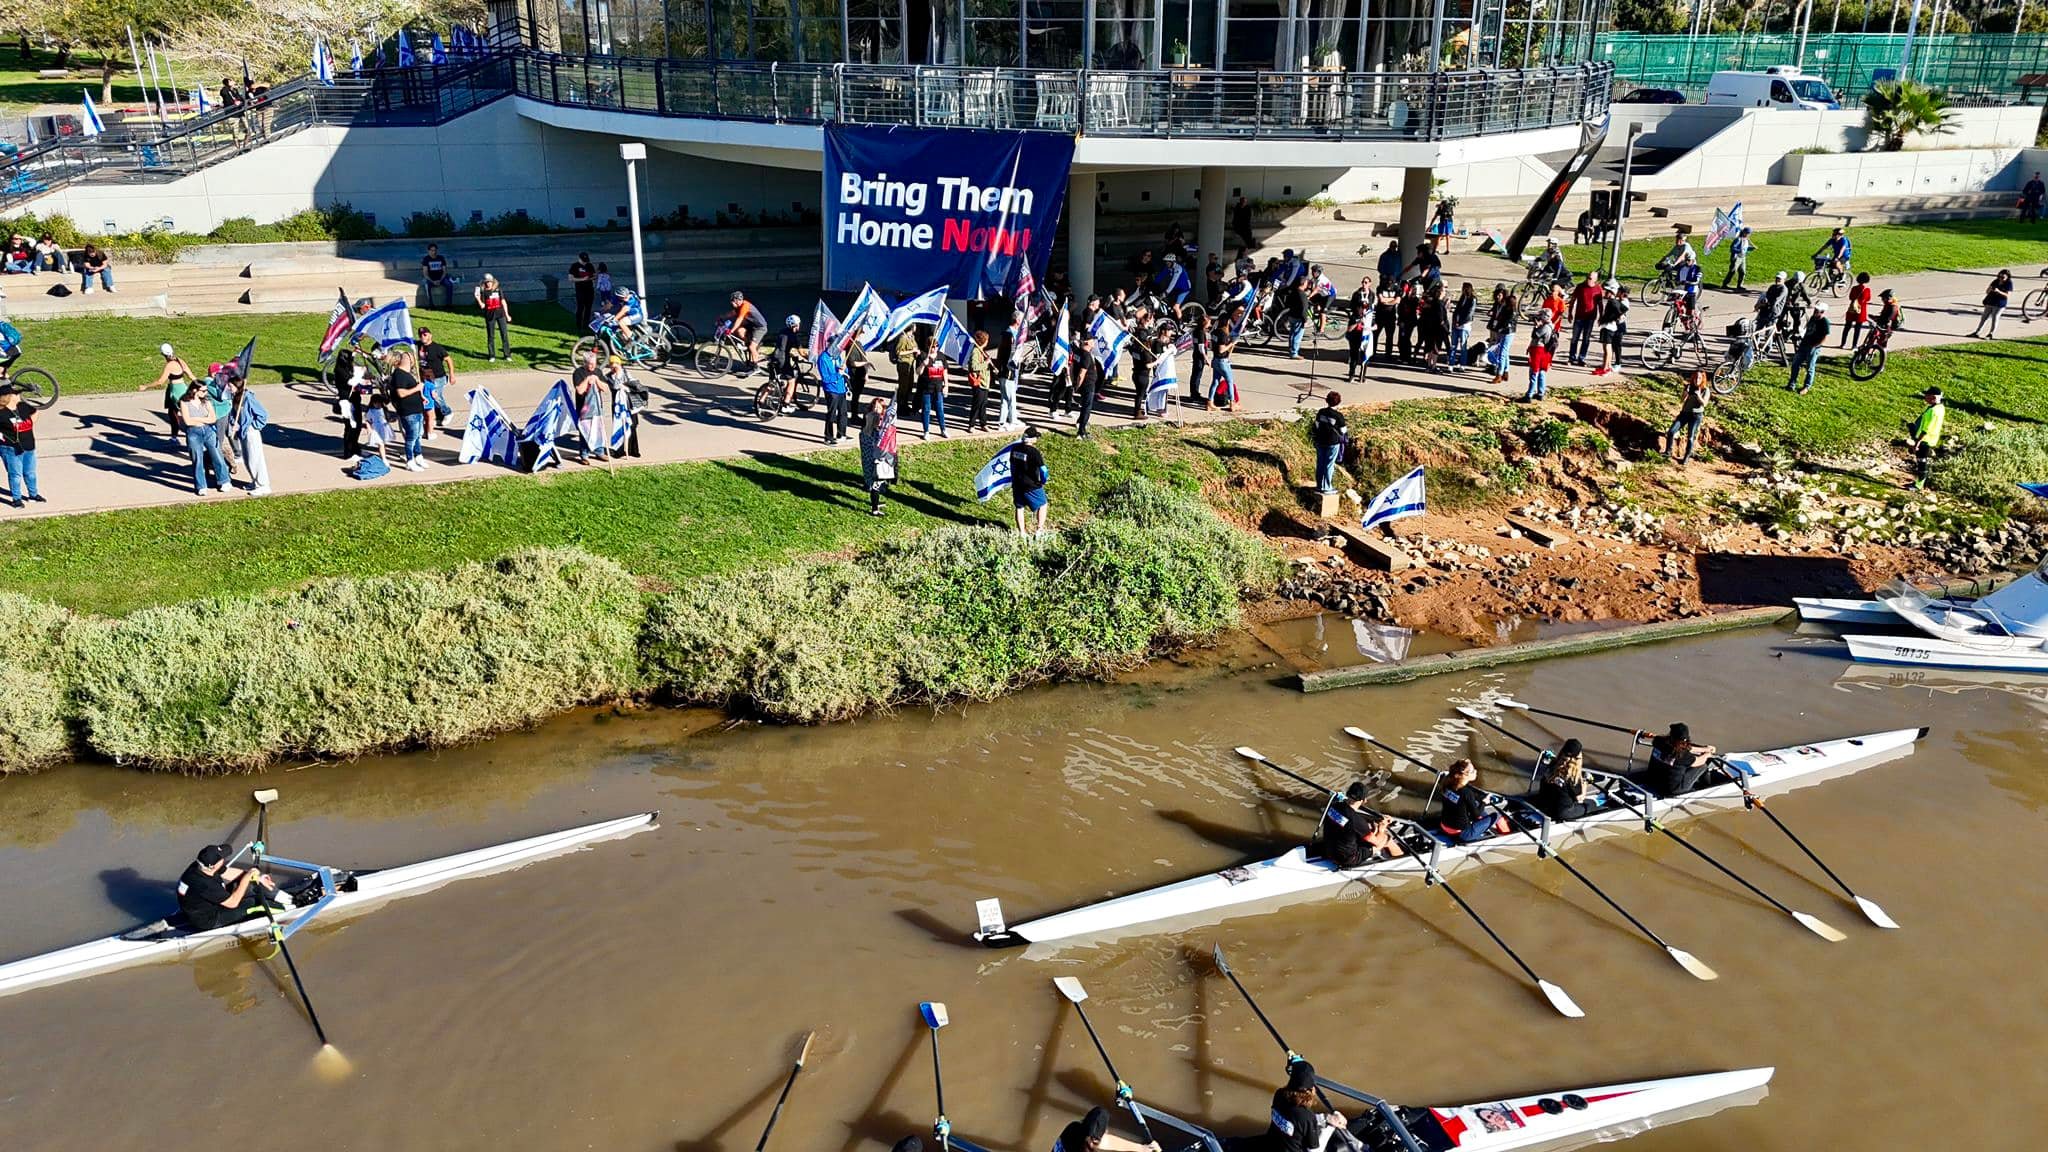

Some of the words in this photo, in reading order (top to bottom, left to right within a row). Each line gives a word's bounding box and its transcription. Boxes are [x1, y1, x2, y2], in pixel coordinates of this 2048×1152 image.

[840, 172, 928, 216] Bring
[937, 176, 1034, 215] Them
[837, 212, 933, 249] Home
[1894, 646, 1931, 660] 50135
